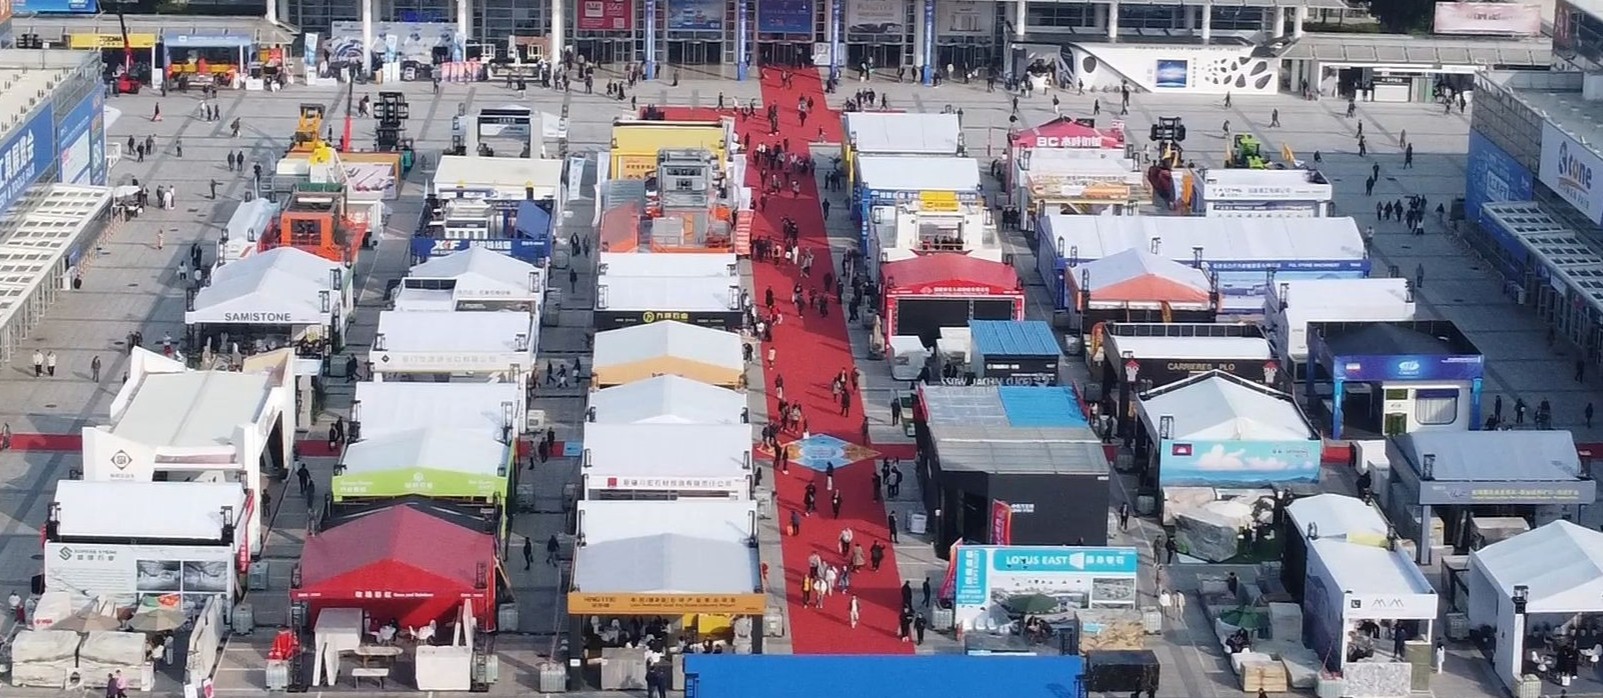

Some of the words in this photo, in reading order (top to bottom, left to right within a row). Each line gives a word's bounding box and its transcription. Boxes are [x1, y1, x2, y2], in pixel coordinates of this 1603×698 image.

[1037, 137, 1058, 147] BC
[225, 312, 292, 322] SAMISTONE
[1219, 363, 1236, 371] PLO
[1006, 556, 1039, 564] LOTUS
[1042, 556, 1067, 564] EAST
